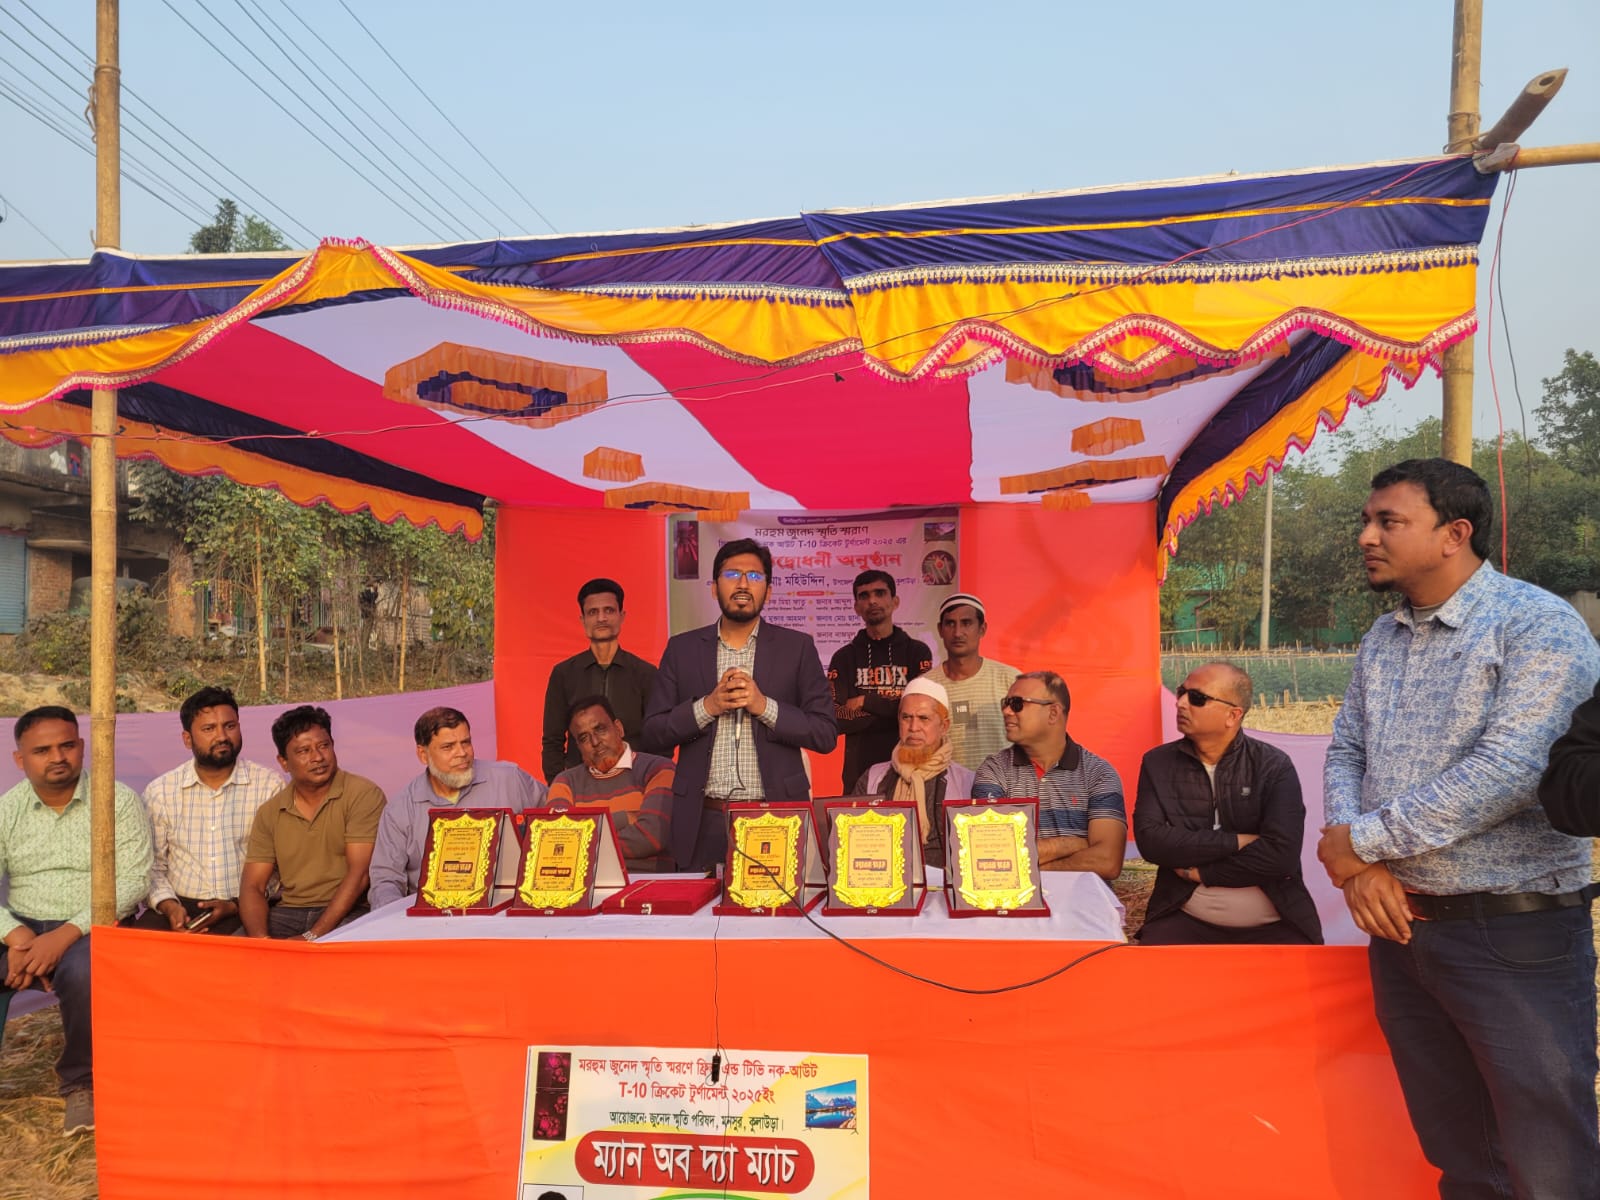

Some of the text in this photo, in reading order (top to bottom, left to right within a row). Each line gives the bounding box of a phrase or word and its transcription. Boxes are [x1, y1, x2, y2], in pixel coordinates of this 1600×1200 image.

[798, 540, 817, 549] T-10
[837, 552, 903, 571] অনুষ্ঠান
[578, 1058, 606, 1075] মরহুম
[609, 1059, 638, 1076] জুনেদ
[640, 1056, 663, 1079] স্মৃতি
[665, 1060, 693, 1075] স্মরণে
[742, 1059, 765, 1077] টিভি
[768, 1061, 818, 1079] নক-আউট
[619, 1081, 647, 1099] T-10
[651, 1080, 686, 1099] ক্রিকেট
[731, 1085, 776, 1104] ২০২৫ইং
[649, 1111, 671, 1128] জুনেদ
[673, 1109, 690, 1132] স্মৃতি
[591, 1138, 800, 1186] ম্যান অব দ্যা ম্যাচ
